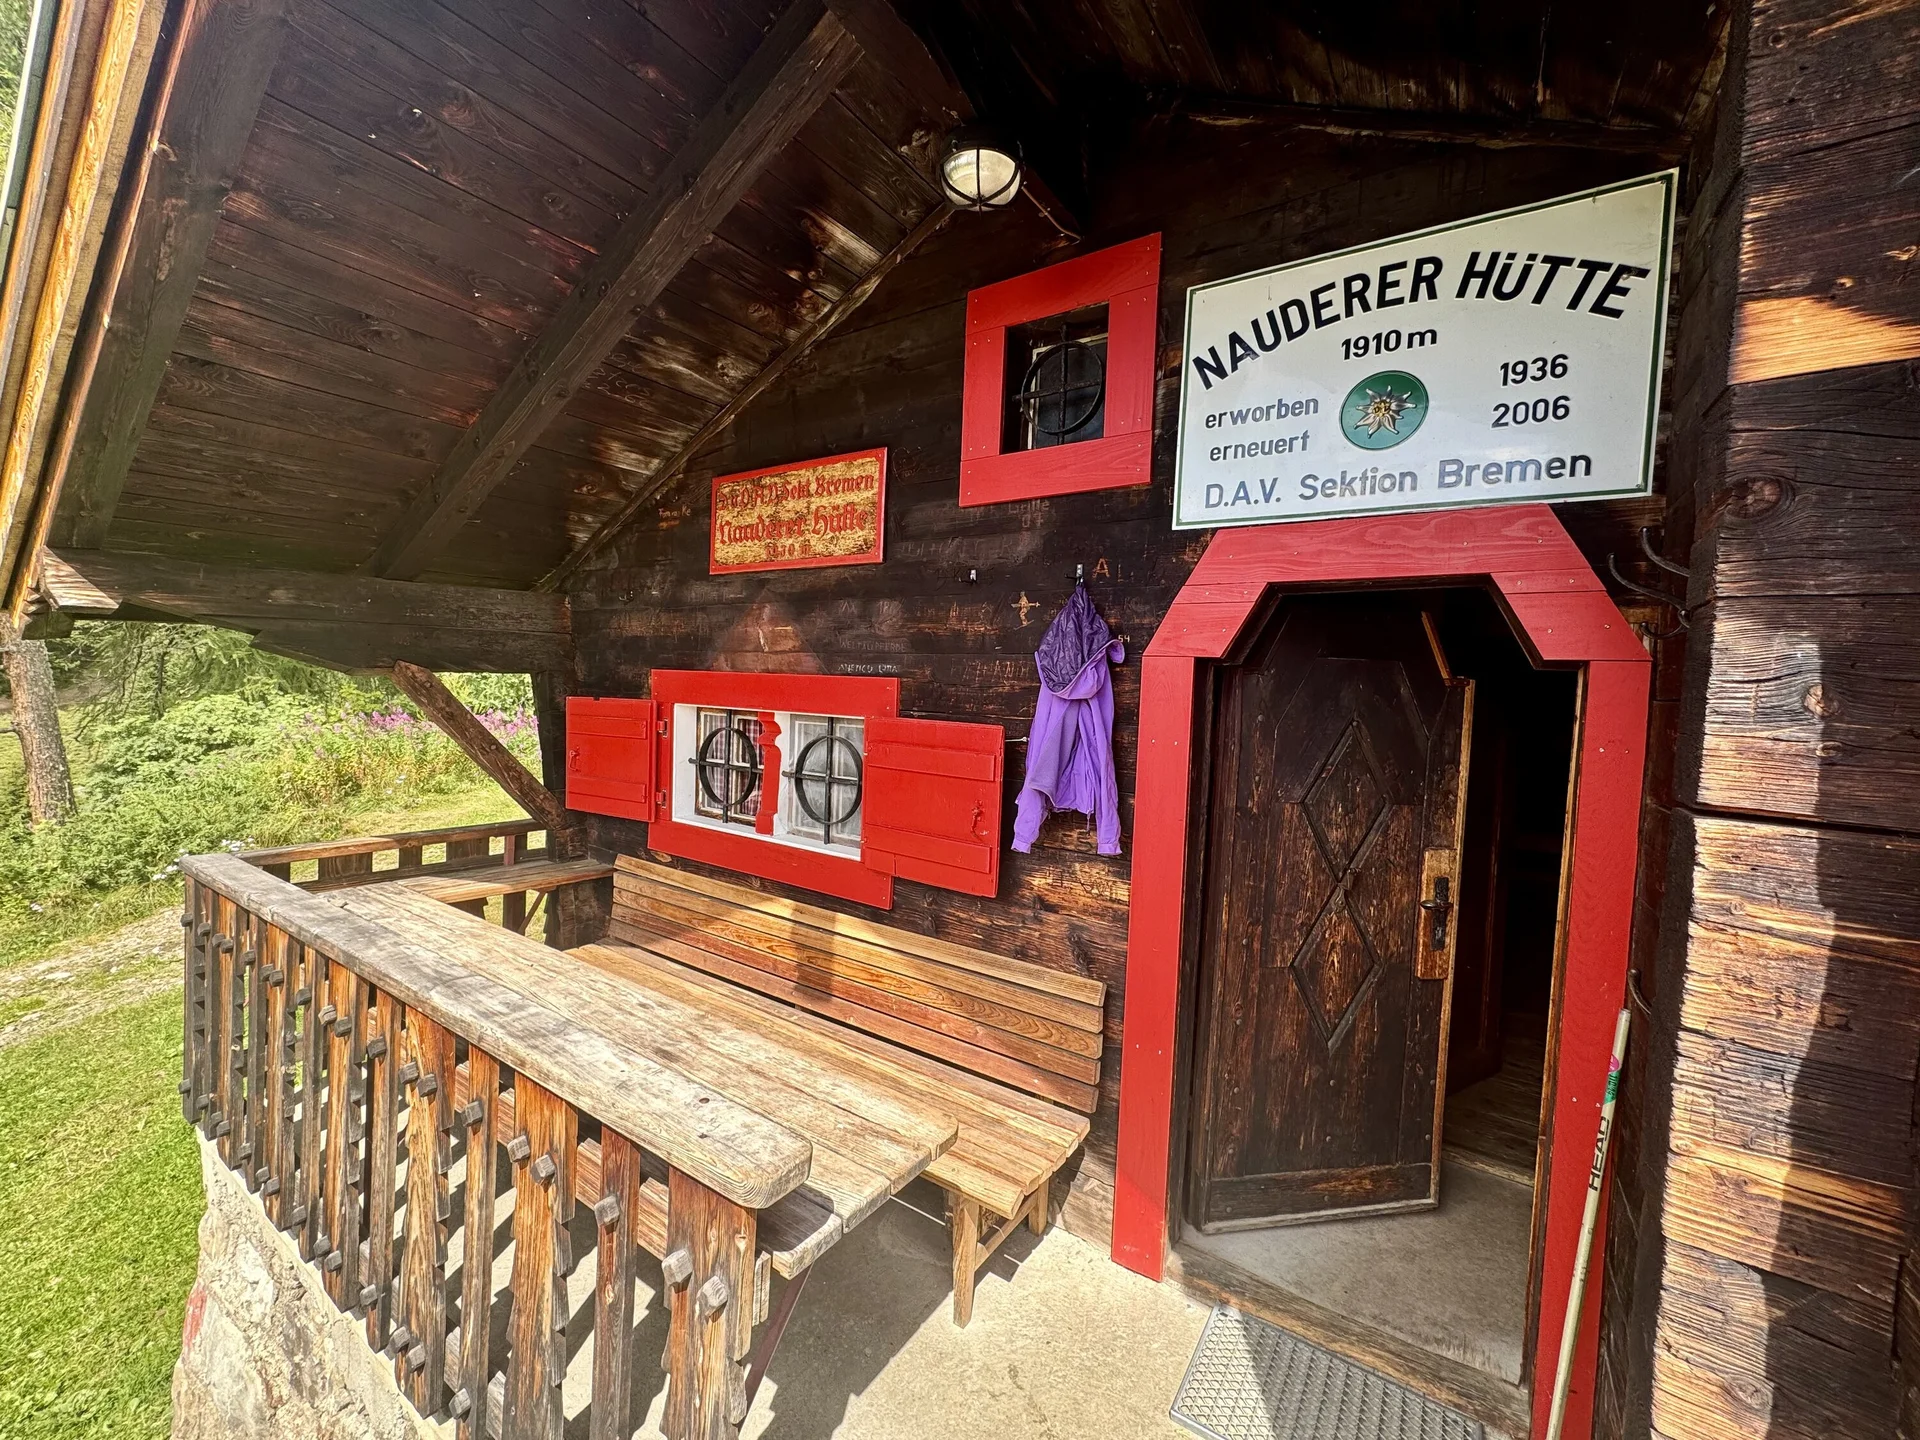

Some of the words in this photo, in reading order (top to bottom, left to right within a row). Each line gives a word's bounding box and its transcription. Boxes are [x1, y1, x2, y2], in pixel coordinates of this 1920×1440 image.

[1191, 256, 1443, 390] NAUDERER
[1455, 251, 1652, 319] HÜTTE
[1340, 328, 1402, 361] 1910
[1407, 327, 1438, 350] m
[1204, 396, 1320, 430] erworben
[1498, 353, 1569, 387] 1936
[1208, 429, 1310, 462] erneuert
[1491, 394, 1571, 429] 2006
[814, 474, 875, 497] Bremen
[1204, 477, 1282, 509] D.A.V.
[1298, 467, 1418, 501] Sektion
[1436, 453, 1593, 490] Bremen
[718, 512, 808, 545] Nauderer
[810, 502, 868, 541] Hütte
[1588, 1115, 1610, 1192] HEAD
